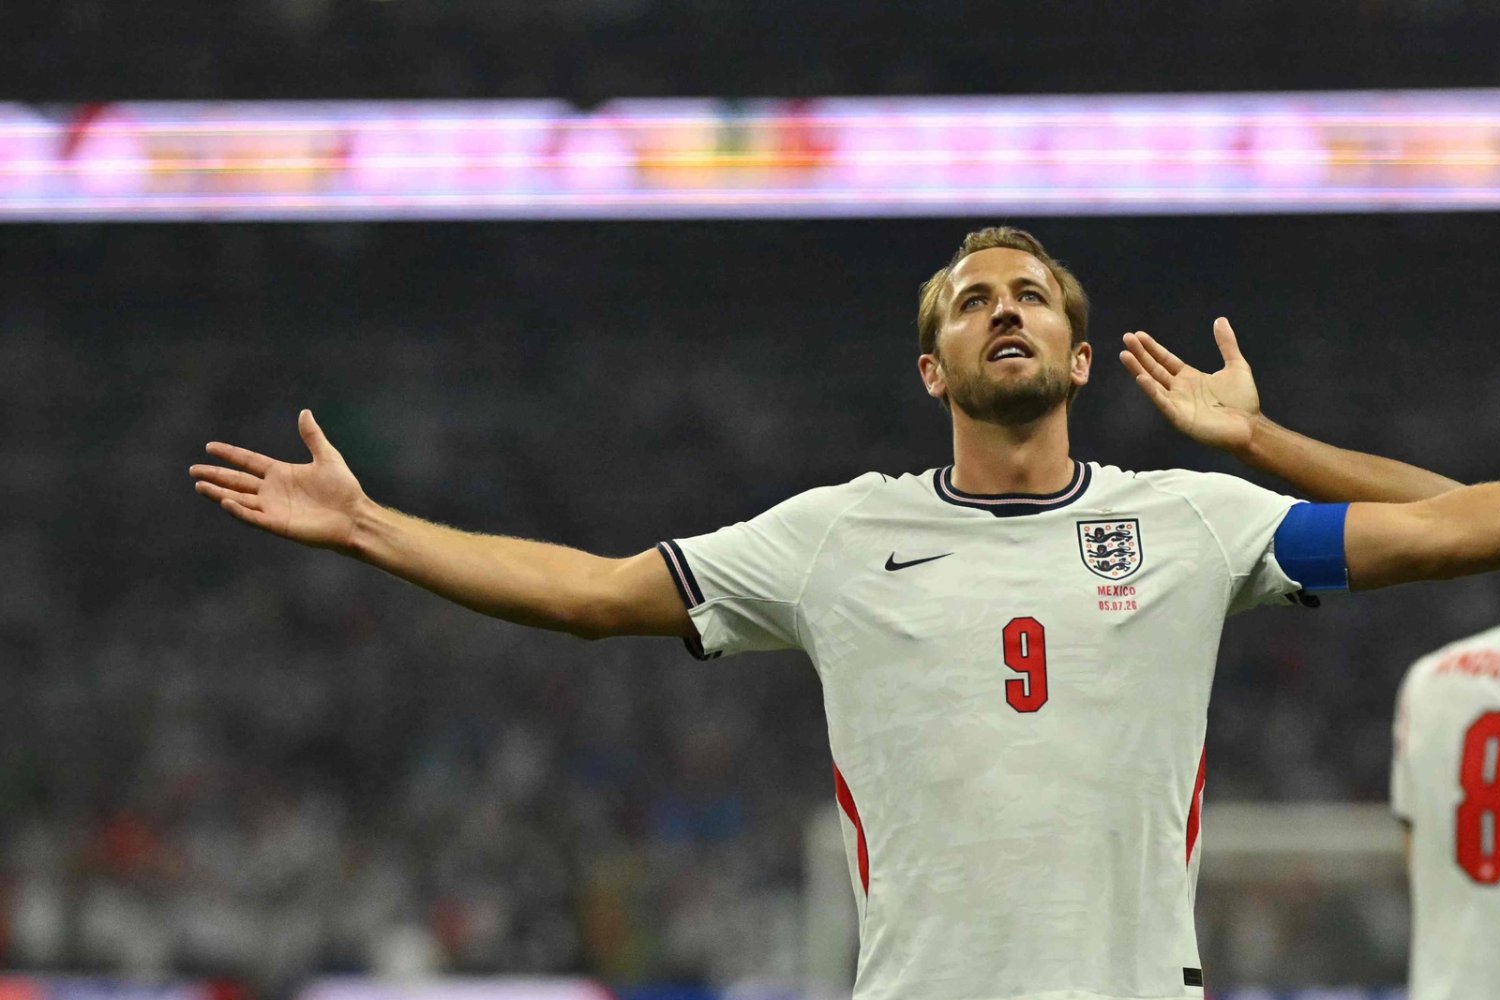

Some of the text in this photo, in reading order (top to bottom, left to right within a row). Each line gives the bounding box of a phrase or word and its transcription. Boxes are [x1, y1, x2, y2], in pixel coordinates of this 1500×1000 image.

[1097, 585, 1136, 597] MEXICO
[1098, 600, 1137, 611] 05.07.26
[1002, 616, 1048, 713] 9
